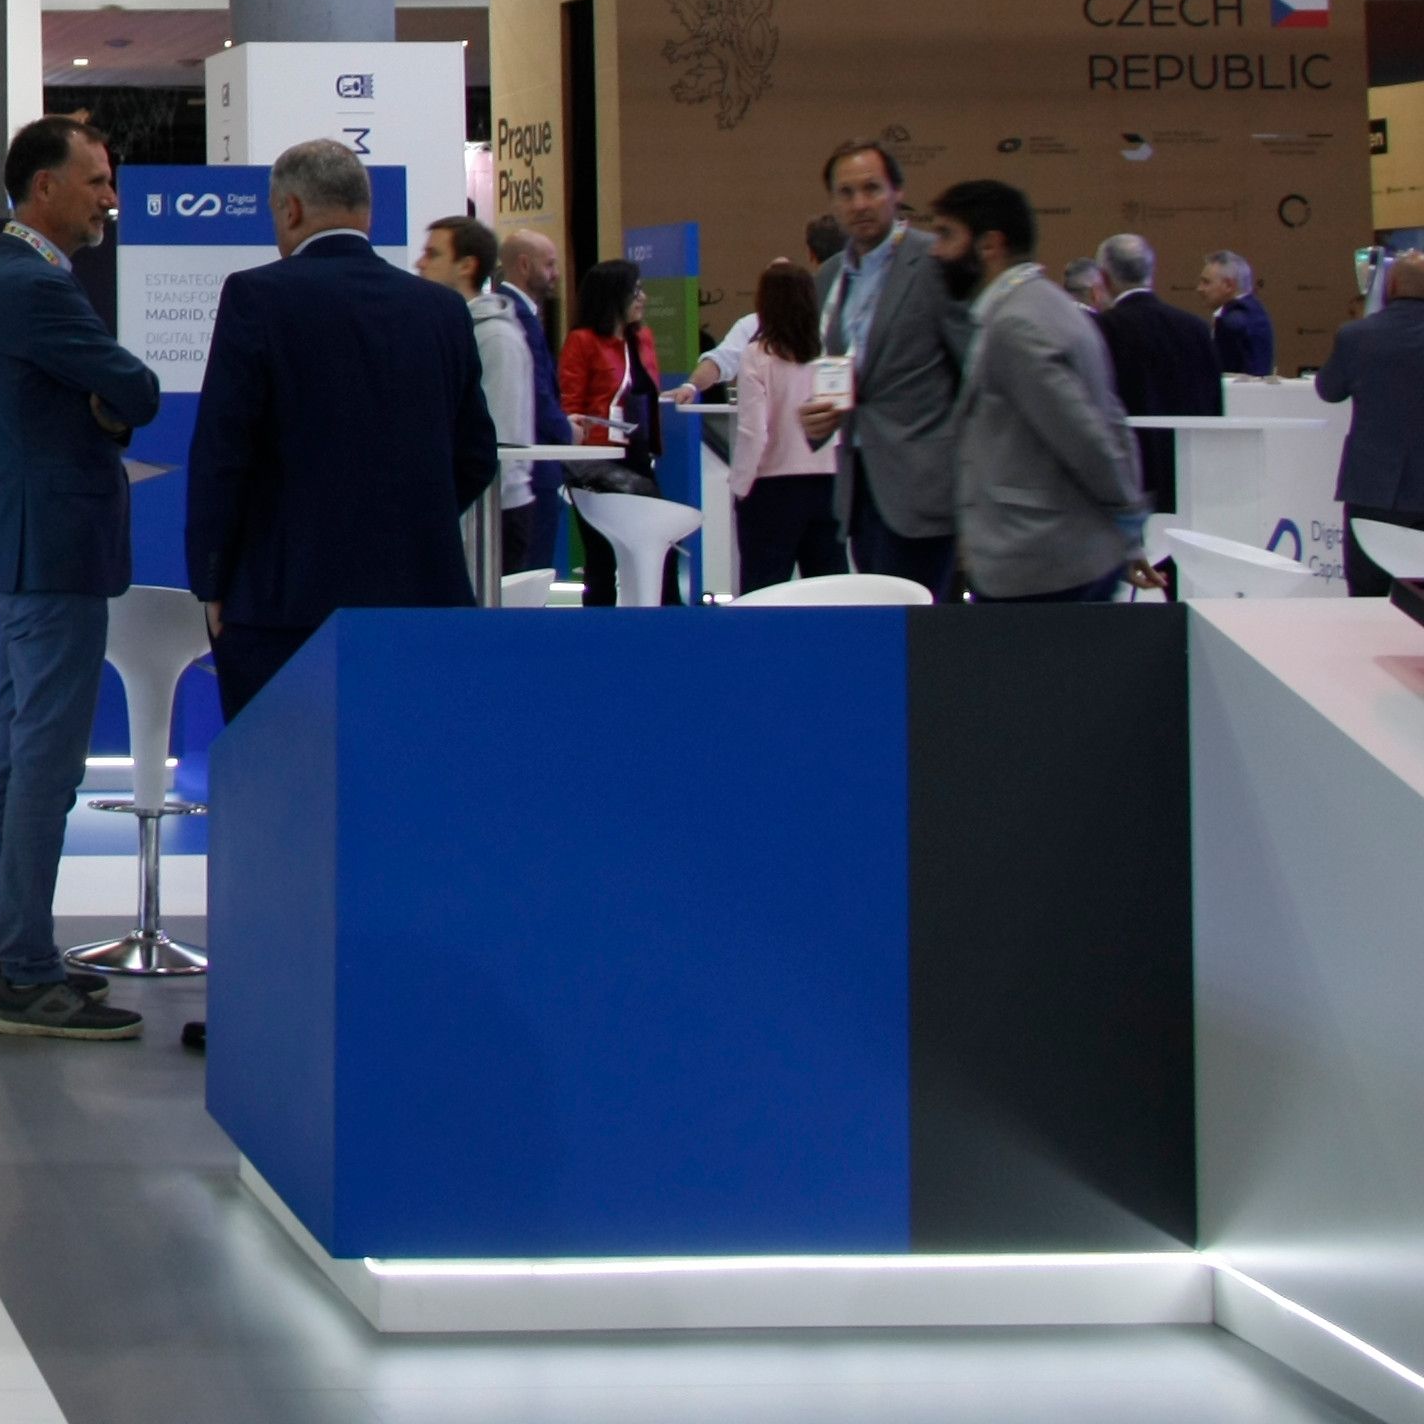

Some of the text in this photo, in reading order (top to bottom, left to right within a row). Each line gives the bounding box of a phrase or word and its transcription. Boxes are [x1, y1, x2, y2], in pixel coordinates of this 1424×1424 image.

[1087, 54, 1332, 90] REPUBLIC
[498, 118, 552, 167] Prague
[499, 166, 544, 213] Pixels
[227, 193, 257, 204] Digital
[225, 205, 257, 216] Capital
[145, 308, 206, 321] MADRID,
[145, 332, 195, 344] DIGITAL
[145, 350, 207, 363] MADRID,
